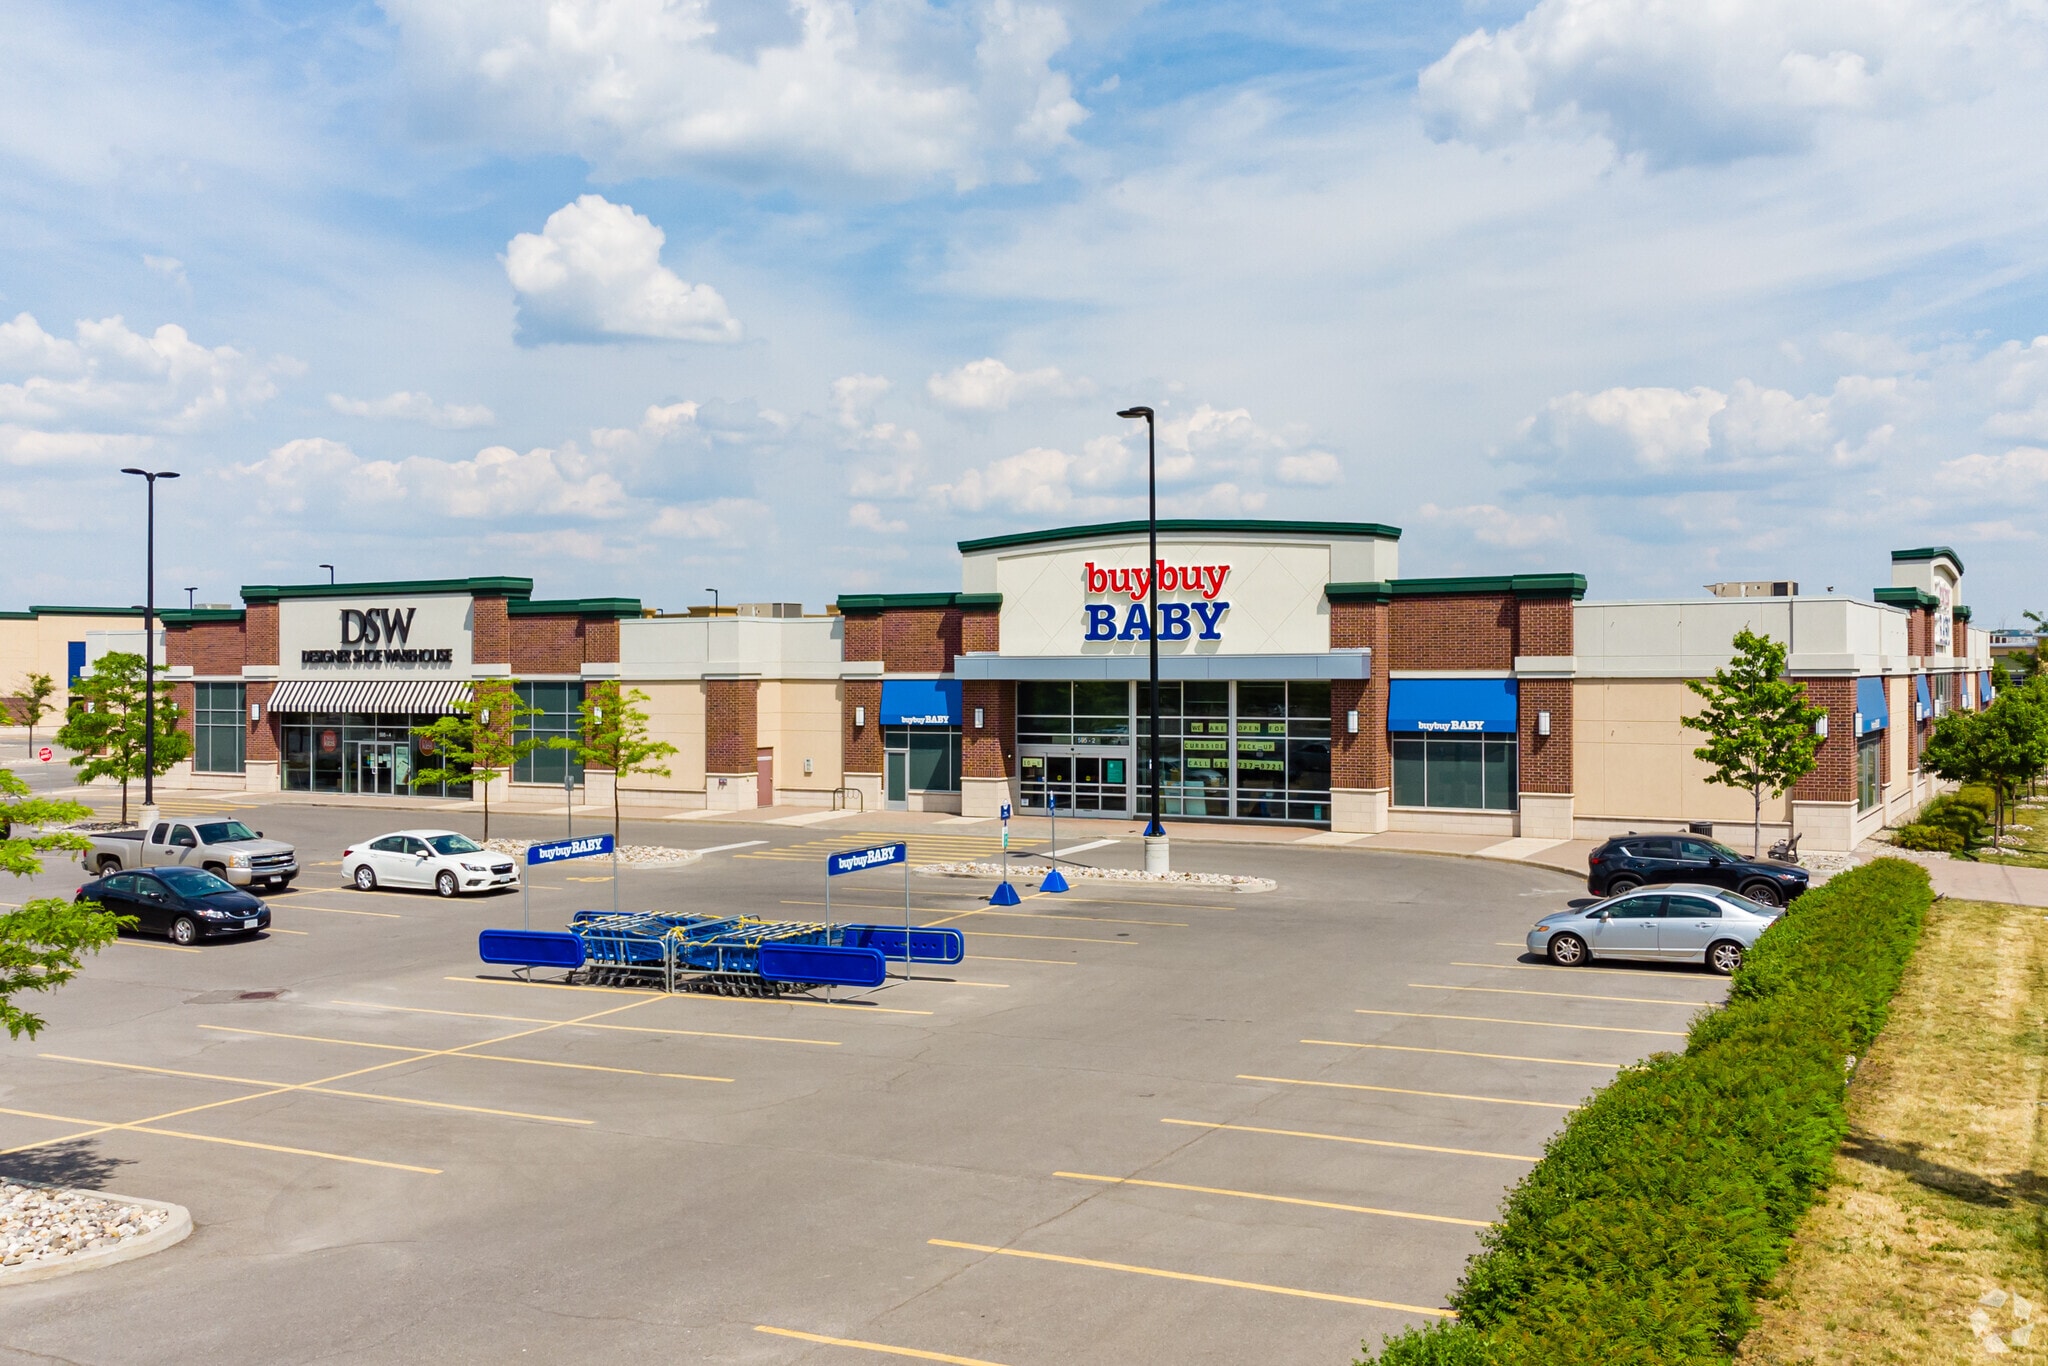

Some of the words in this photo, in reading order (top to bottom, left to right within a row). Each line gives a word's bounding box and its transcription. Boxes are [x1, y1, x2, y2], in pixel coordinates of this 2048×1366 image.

[1085, 559, 1230, 601] buybuy
[339, 607, 417, 644] DSW
[1085, 602, 1230, 641] BABY
[302, 649, 352, 664] DESIGNER
[353, 649, 383, 664] SHOE
[384, 648, 453, 663] WAREHOUSE
